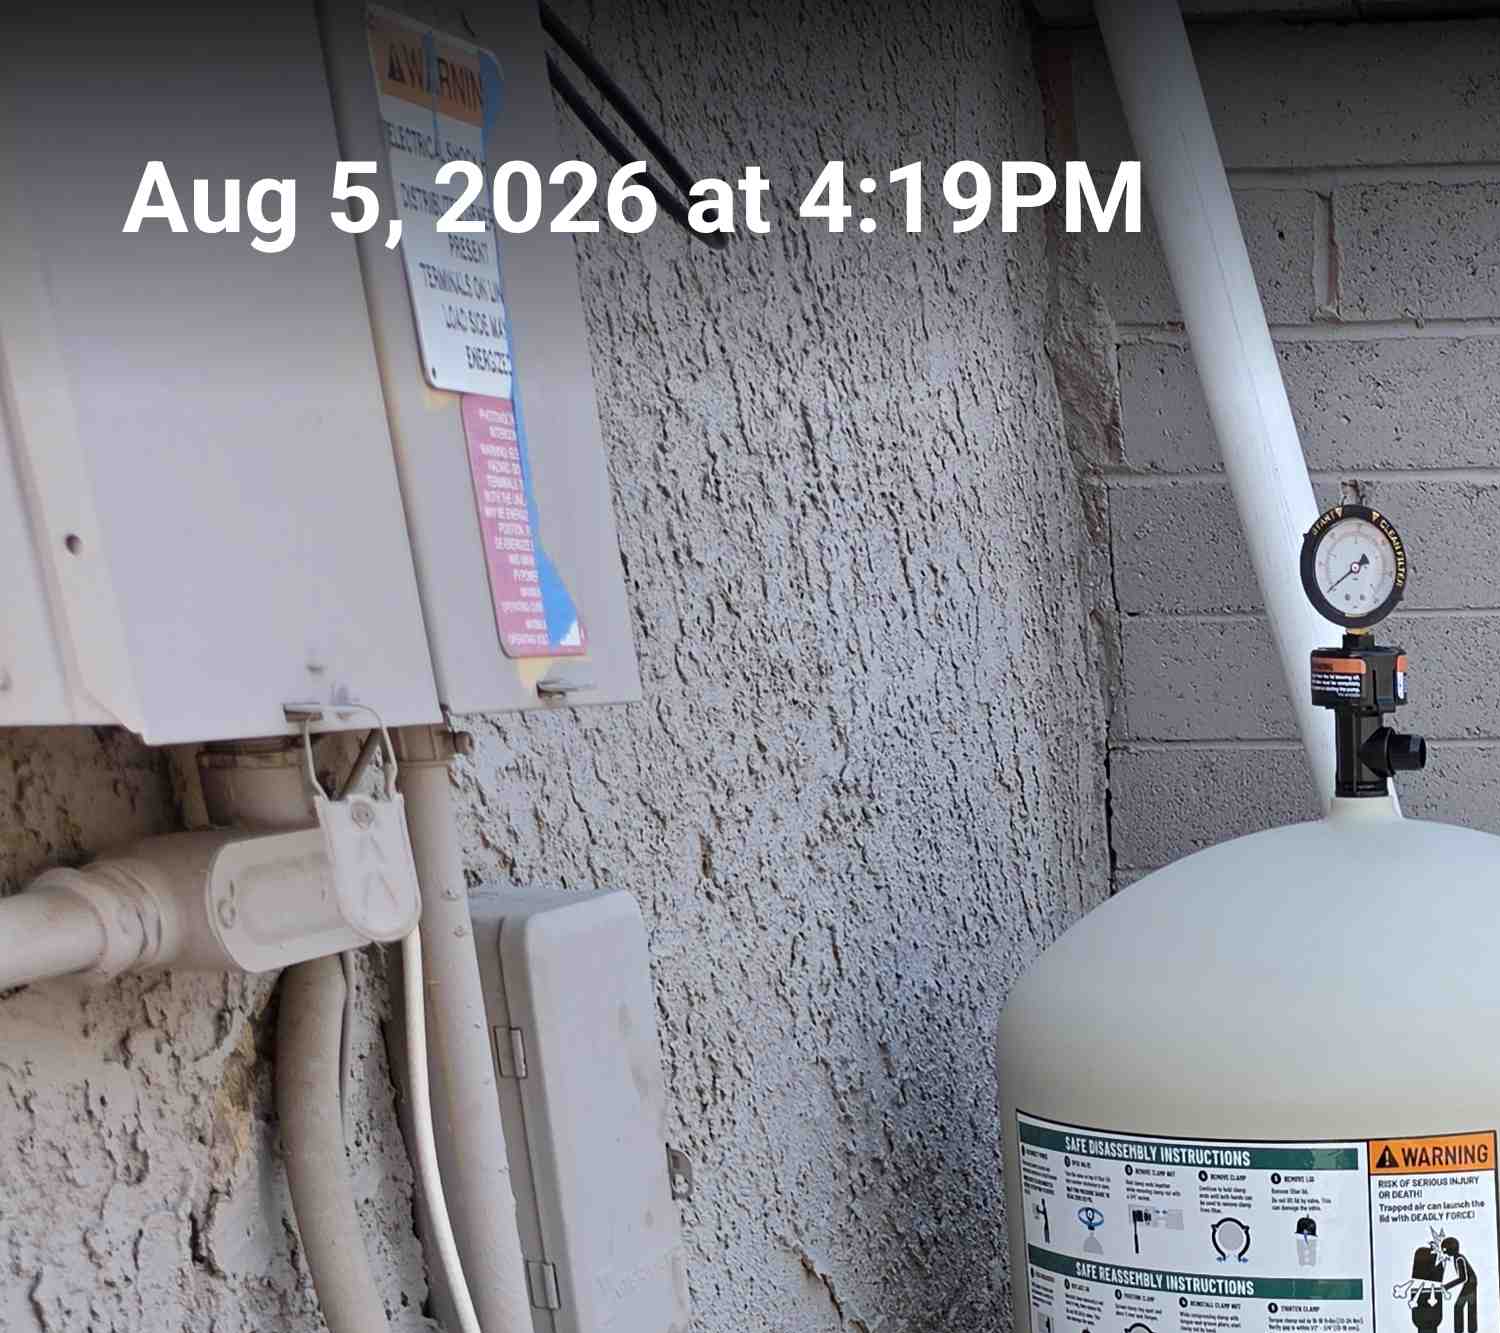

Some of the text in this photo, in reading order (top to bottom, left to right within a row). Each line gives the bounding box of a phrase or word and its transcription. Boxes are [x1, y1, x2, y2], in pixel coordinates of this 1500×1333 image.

[1380, 519, 1401, 550] CLEAN
[1395, 550, 1406, 589] FILTER
[1065, 1136, 1251, 1167] SAFE DISASSEMBLY INSTRUCTIONS
[1401, 1144, 1488, 1167] WARNING
[1378, 1175, 1480, 1188] RISK OF SERIOUS INJURY
[1378, 1189, 1423, 1199] OR DEATH!
[1379, 1203, 1413, 1214] Trapped
[1414, 1201, 1426, 1211] air
[1443, 1200, 1470, 1210] launch
[1471, 1199, 1485, 1208] the
[1379, 1210, 1475, 1223] lid with DEADLY FORCE!
[1075, 1262, 1255, 1296] SAFE REASSEMBLY INSTRUCTIONS
